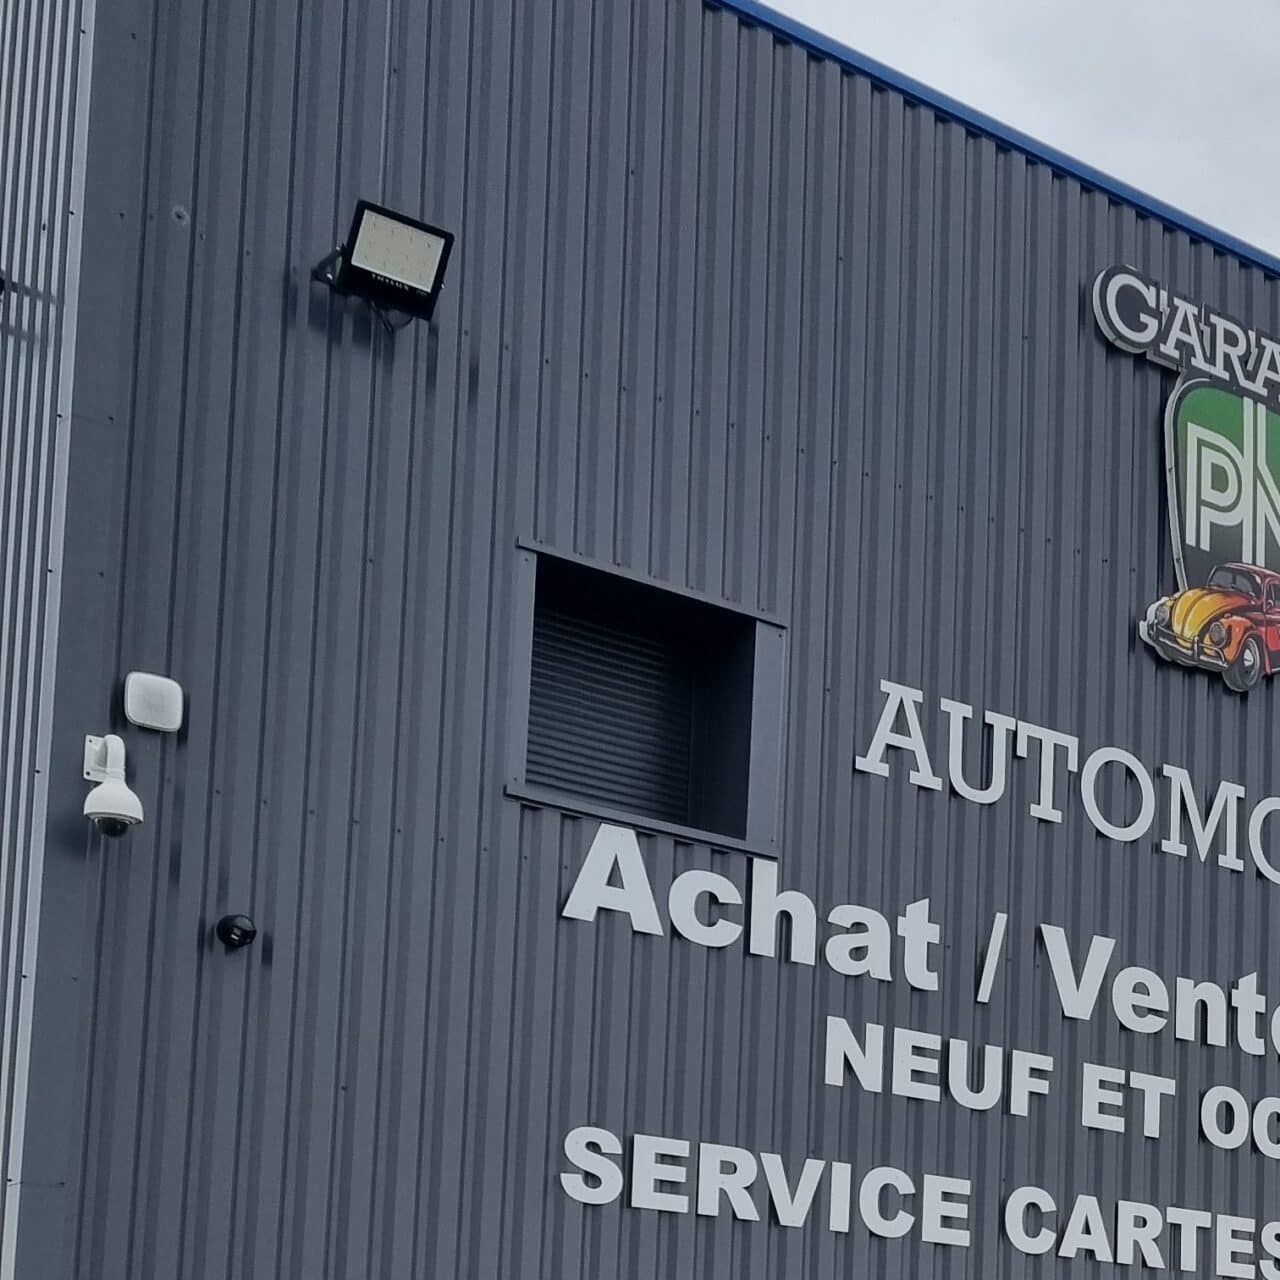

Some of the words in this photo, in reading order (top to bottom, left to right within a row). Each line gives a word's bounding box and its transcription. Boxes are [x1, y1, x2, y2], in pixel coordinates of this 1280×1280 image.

[562, 823, 942, 991] Achat
[977, 911, 1008, 1003] /
[824, 1015, 1054, 1117] NEUF
[1081, 1062, 1176, 1139] ET
[559, 1126, 972, 1247] SERVICE
